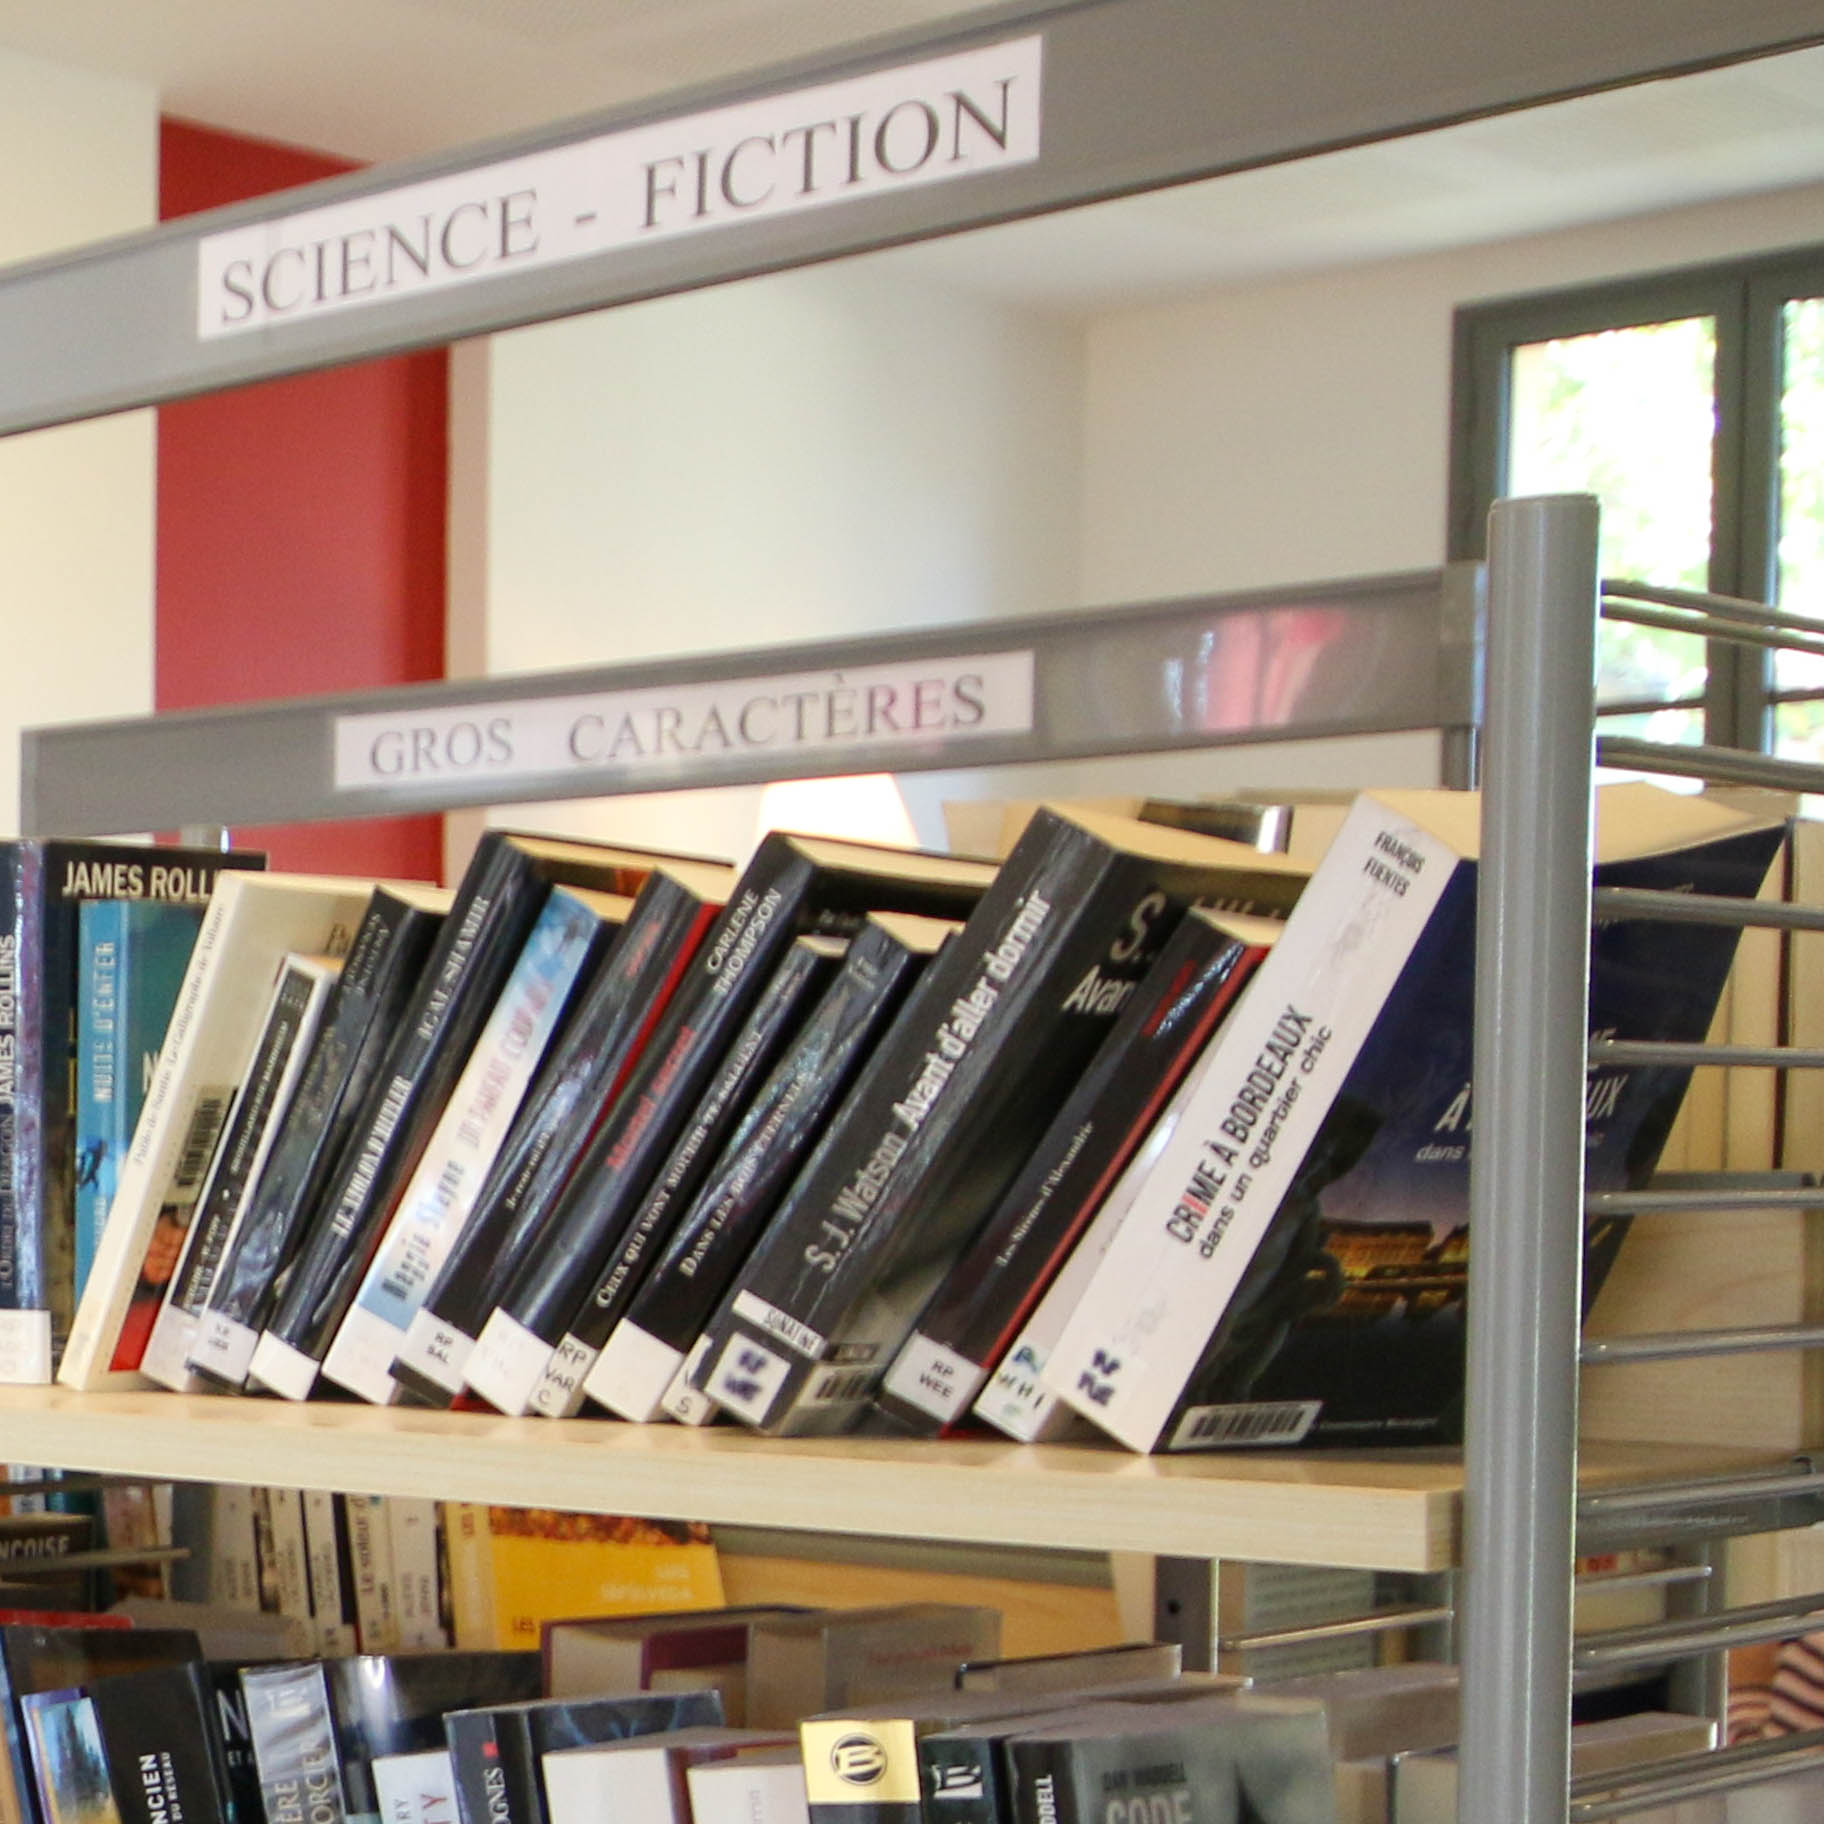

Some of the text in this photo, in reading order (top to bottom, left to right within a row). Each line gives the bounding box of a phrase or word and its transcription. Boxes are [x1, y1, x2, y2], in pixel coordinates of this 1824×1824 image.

[220, 77, 1016, 323] SCIENCE - FICTION
[372, 674, 986, 776] GROS CARACTÈRES
[1373, 831, 1424, 874] FRANÇOIS
[62, 862, 144, 899] JAMES
[1363, 859, 1409, 898] FUENTES
[437, 892, 492, 988] SHAMIR
[702, 887, 762, 972] CARLENE
[711, 886, 785, 997] THOMPSON
[1063, 964, 1132, 1012] Avan
[831, 1126, 911, 1226] Watson
[887, 1050, 957, 1129] Avant
[931, 972, 1005, 1061] d'aller
[978, 885, 1057, 980] dormir
[1157, 1009, 1318, 1242] CRIME À BORDEAUX
[1194, 1022, 1336, 1260] dans un quartier chic
[1415, 1143, 1463, 1164] dans
[428, 1348, 450, 1364] SAL
[558, 1341, 587, 1366] RP
[931, 1362, 954, 1378] RP
[919, 1370, 953, 1398] WEE
